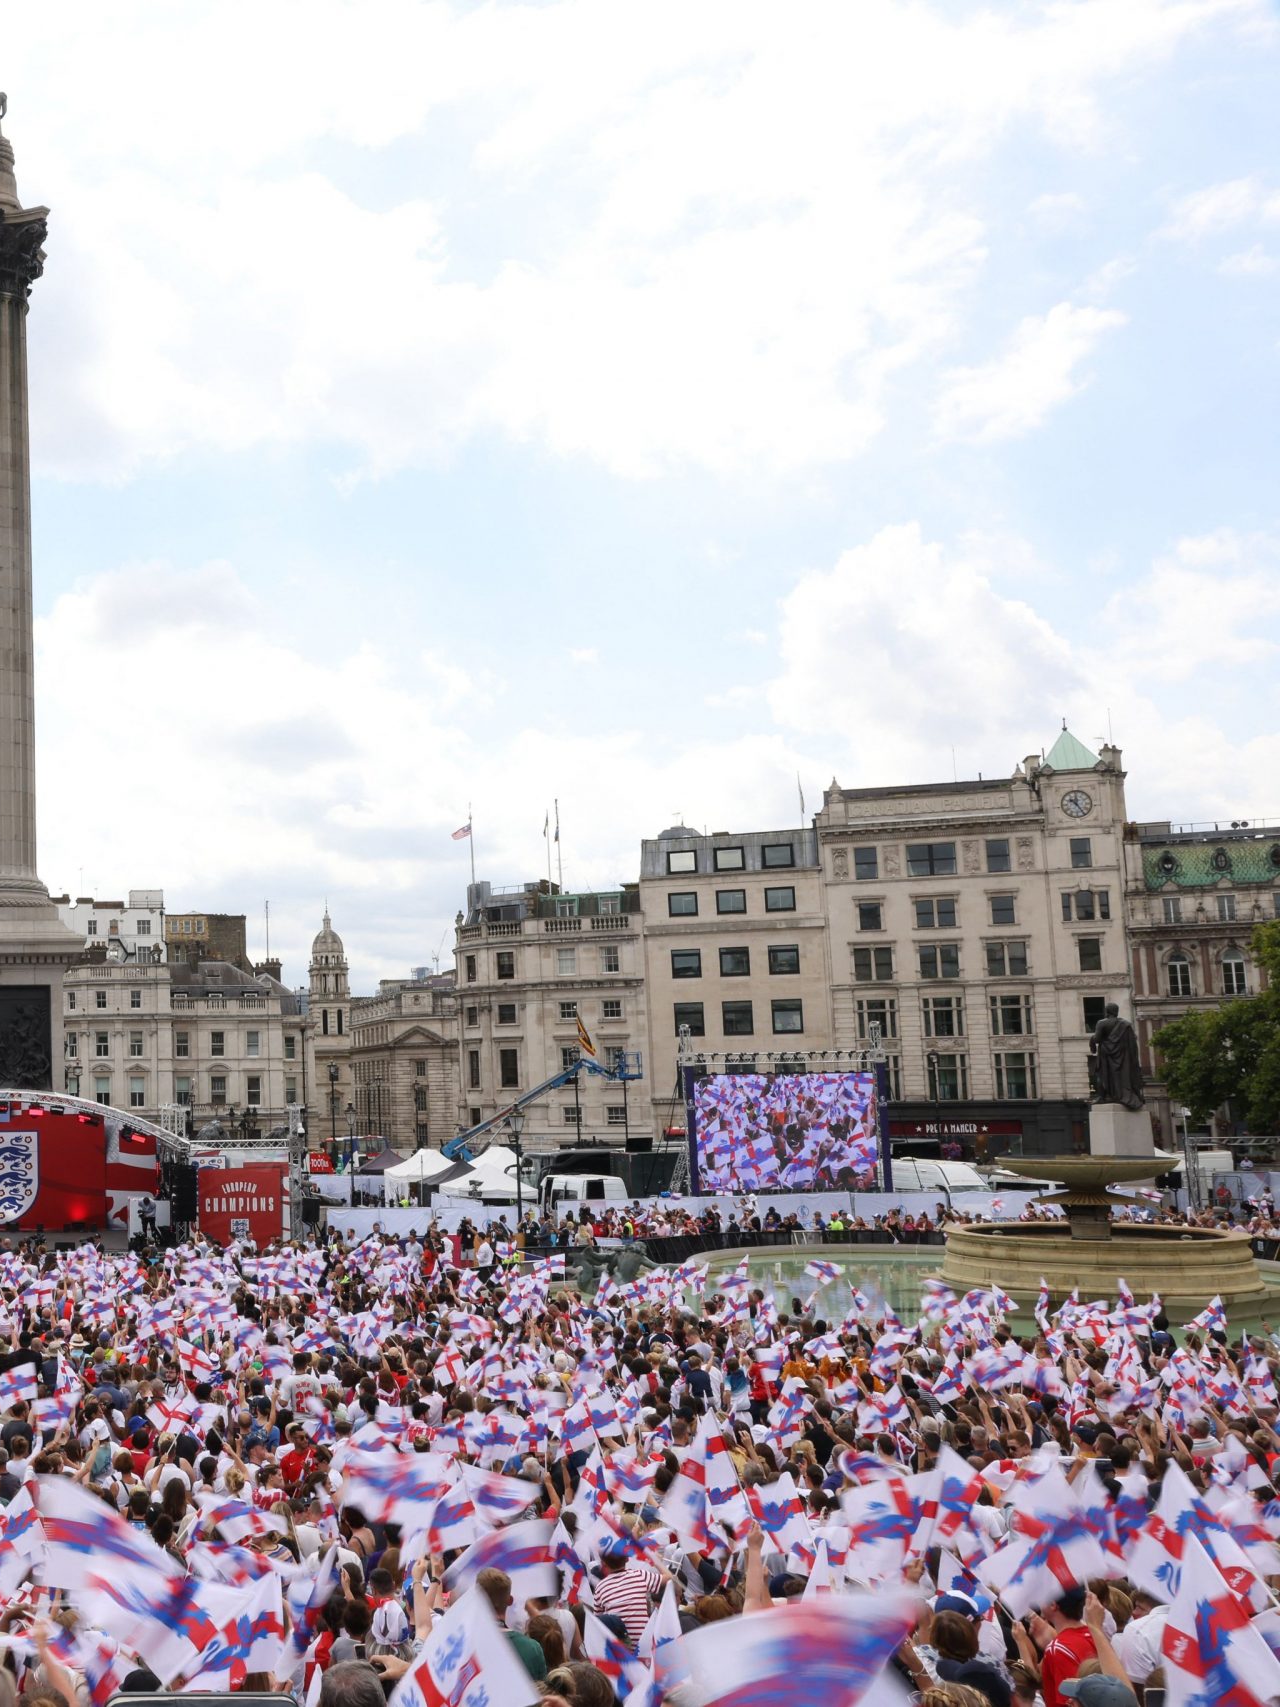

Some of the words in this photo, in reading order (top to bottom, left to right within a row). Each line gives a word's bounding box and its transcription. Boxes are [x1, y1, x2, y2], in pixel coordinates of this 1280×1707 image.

[851, 800, 934, 817] CANADIAN
[943, 793, 1009, 811] PACIFIC
[925, 1123, 942, 1133] PRET
[944, 1123, 949, 1133] A
[950, 1123, 978, 1133] MANGER
[221, 1181, 258, 1194] EUROPEAN
[205, 1197, 275, 1213] CHAMPIONS
